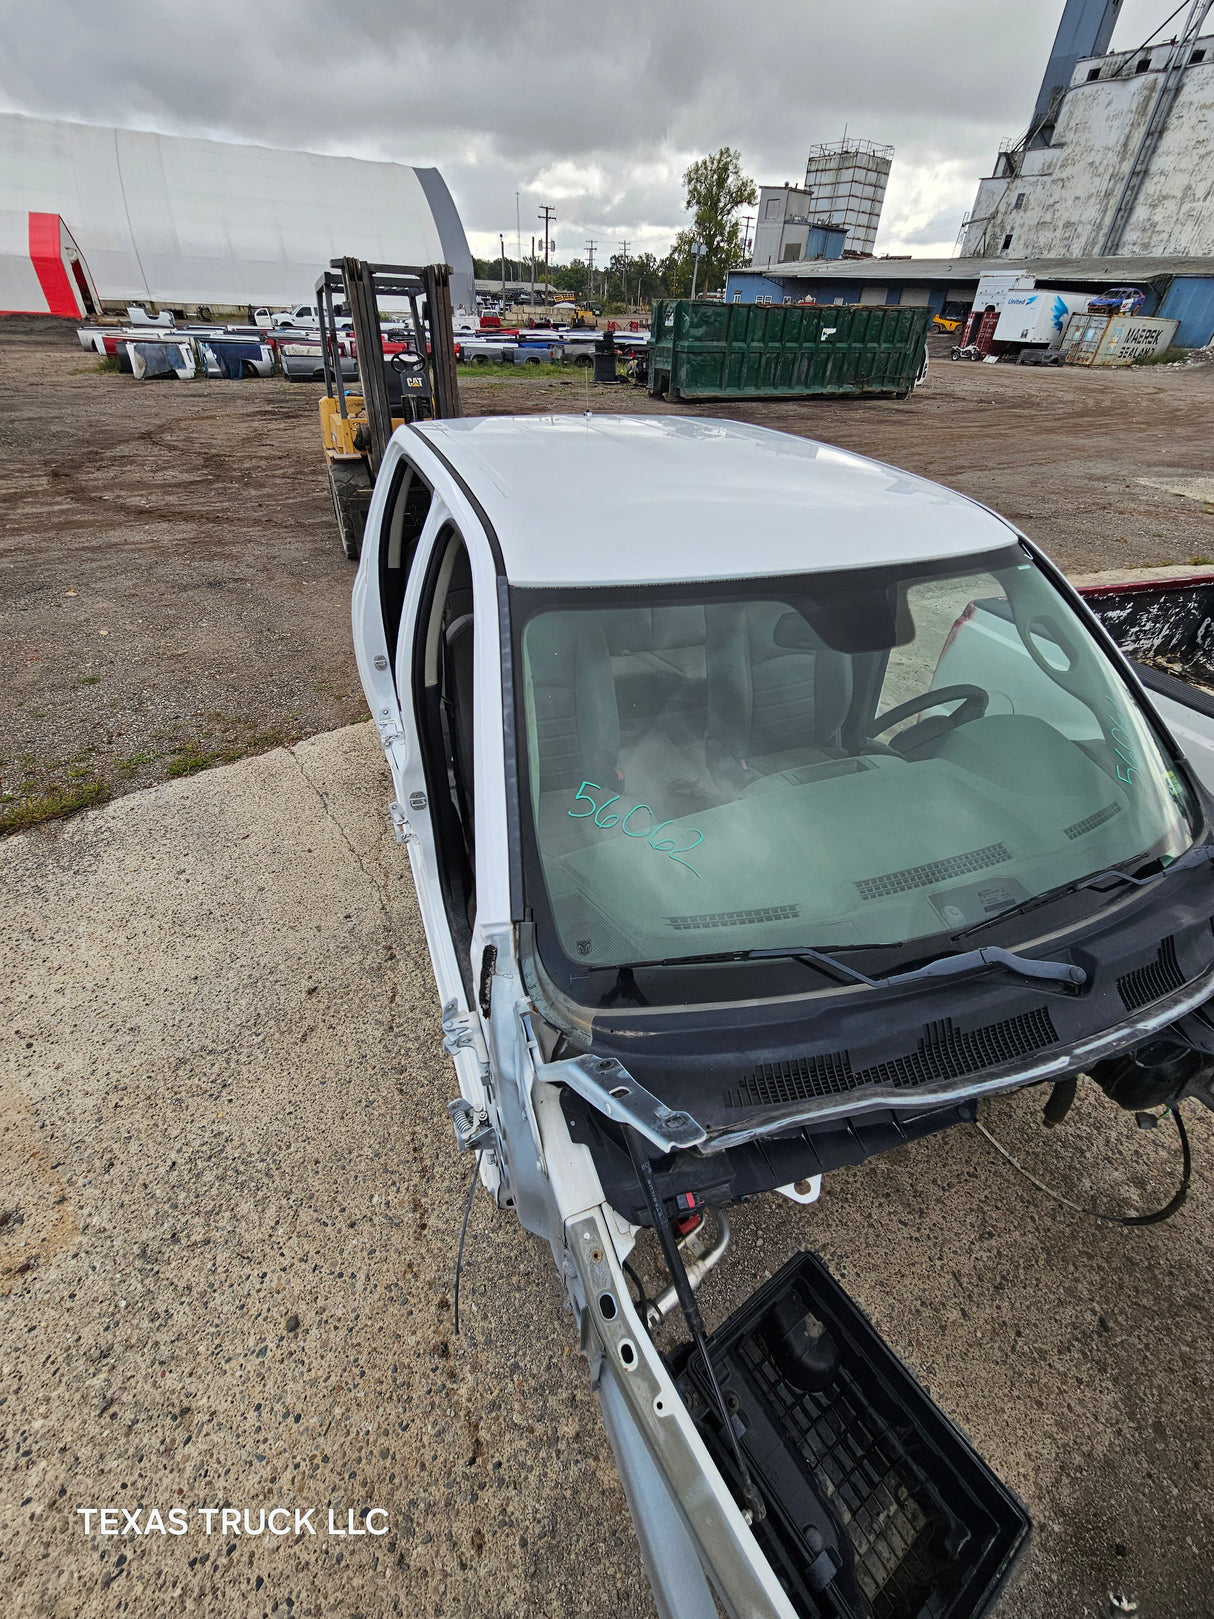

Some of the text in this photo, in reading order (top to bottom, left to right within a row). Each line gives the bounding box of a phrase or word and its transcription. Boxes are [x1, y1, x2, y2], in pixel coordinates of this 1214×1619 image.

[1124, 328, 1163, 345] MAERSK
[406, 377, 423, 387] CAT
[567, 780, 704, 878] 56062
